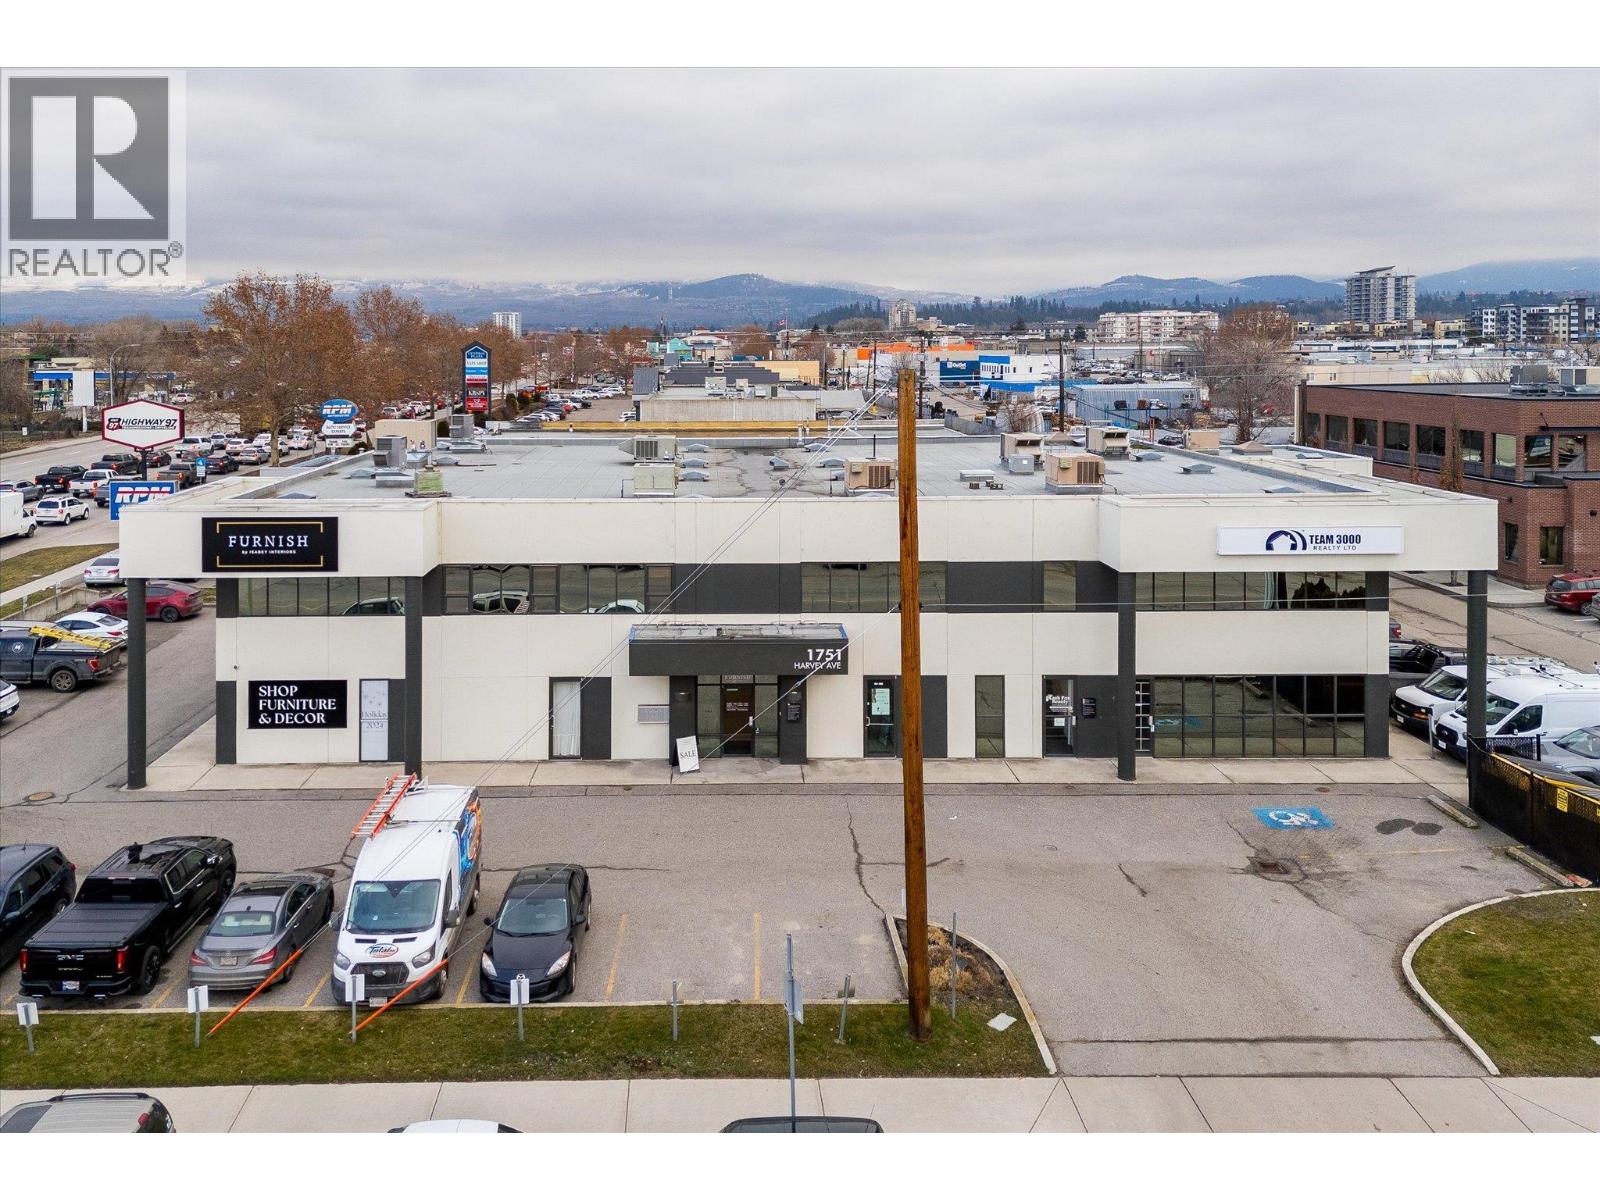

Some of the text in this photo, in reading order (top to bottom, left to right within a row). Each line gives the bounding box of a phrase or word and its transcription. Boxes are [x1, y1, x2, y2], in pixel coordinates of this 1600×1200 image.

[322, 405, 352, 414] RPM
[165, 418, 178, 428] 97
[228, 535, 309, 547] FURNISH
[1309, 534, 1362, 544] TEAM 3000
[807, 649, 842, 661] 1751
[793, 662, 842, 670] HARVEY AVE
[258, 685, 298, 697] SHOP
[258, 698, 337, 711] FURNITURE
[258, 712, 326, 724] & DECOR
[680, 749, 697, 759] SALE
